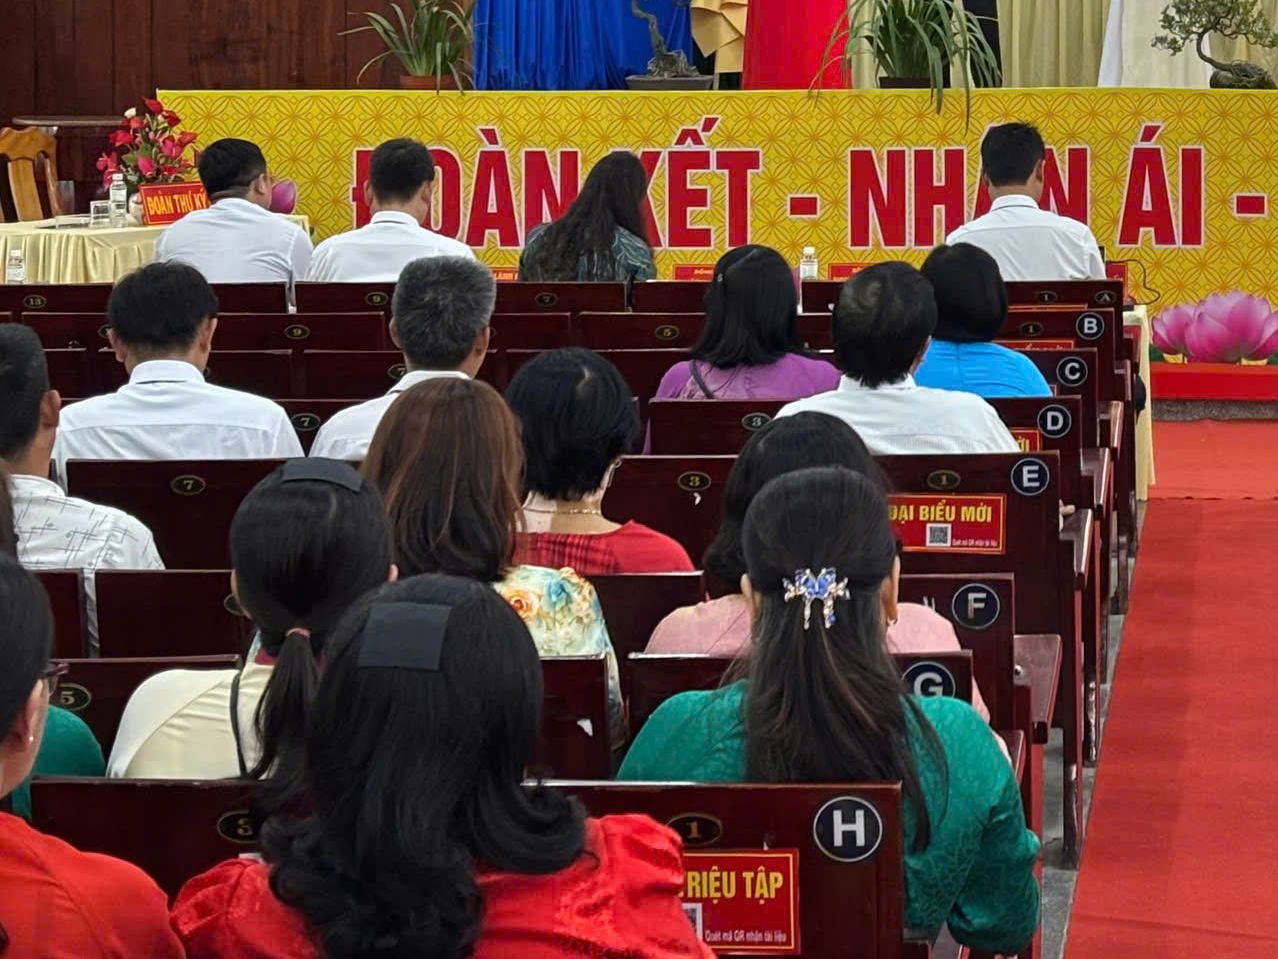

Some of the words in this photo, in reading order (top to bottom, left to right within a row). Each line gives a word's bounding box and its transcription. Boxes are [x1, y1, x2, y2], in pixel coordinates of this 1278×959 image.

[790, 196, 818, 216] -
[1119, 124, 1202, 245] ÁI
[1235, 195, 1266, 215] -
[146, 190, 174, 216] ĐOÀN
[1100, 293, 1111, 301] A
[1084, 318, 1098, 333] B
[1064, 362, 1080, 380] C
[300, 417, 309, 426] 7
[752, 417, 761, 426] 3
[1046, 412, 1064, 430] D
[184, 480, 193, 489] 7
[690, 477, 699, 487] 3
[1022, 467, 1039, 489] E
[919, 499, 956, 522] BIỂU
[961, 502, 992, 523] MỜI
[968, 593, 986, 619] F
[914, 672, 944, 697] G
[61, 690, 75, 705] 5
[687, 822, 700, 838] 1
[833, 809, 865, 847] H
[679, 865, 736, 904] RIỆU
[742, 865, 783, 904] TẬP
